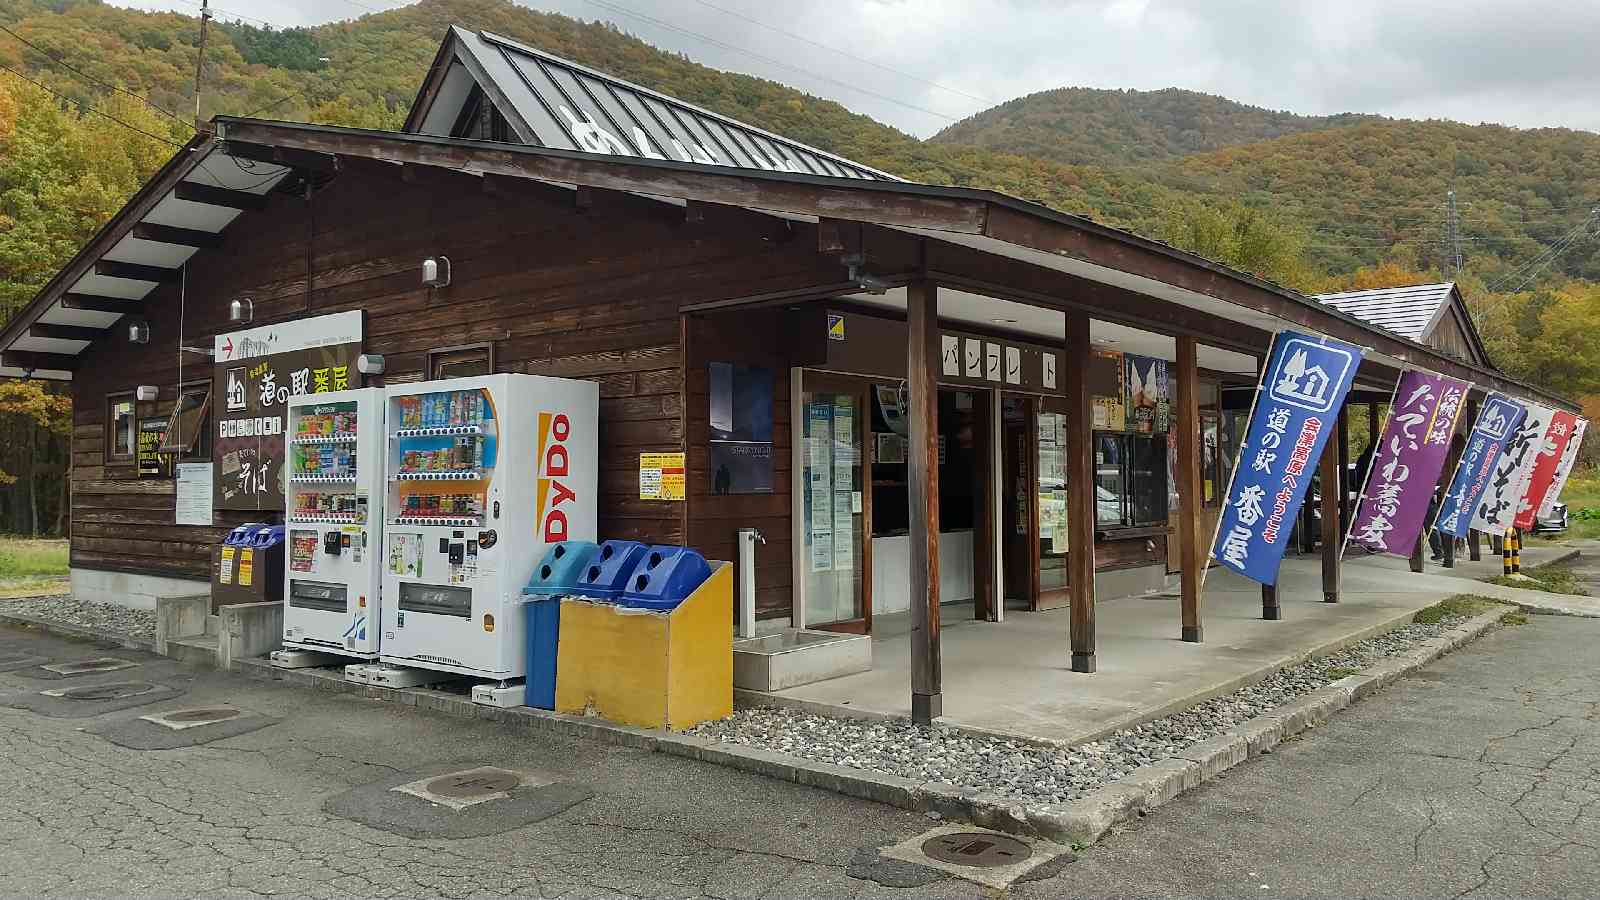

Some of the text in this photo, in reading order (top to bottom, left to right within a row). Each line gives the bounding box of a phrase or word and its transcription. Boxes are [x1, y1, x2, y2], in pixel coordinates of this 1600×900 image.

[239, 459, 272, 495] そば
[1221, 408, 1292, 570] 道の駅 番屋
[1262, 416, 1322, 544] 会津高原へようこそ
[1360, 384, 1435, 549] たていわ蕎麦
